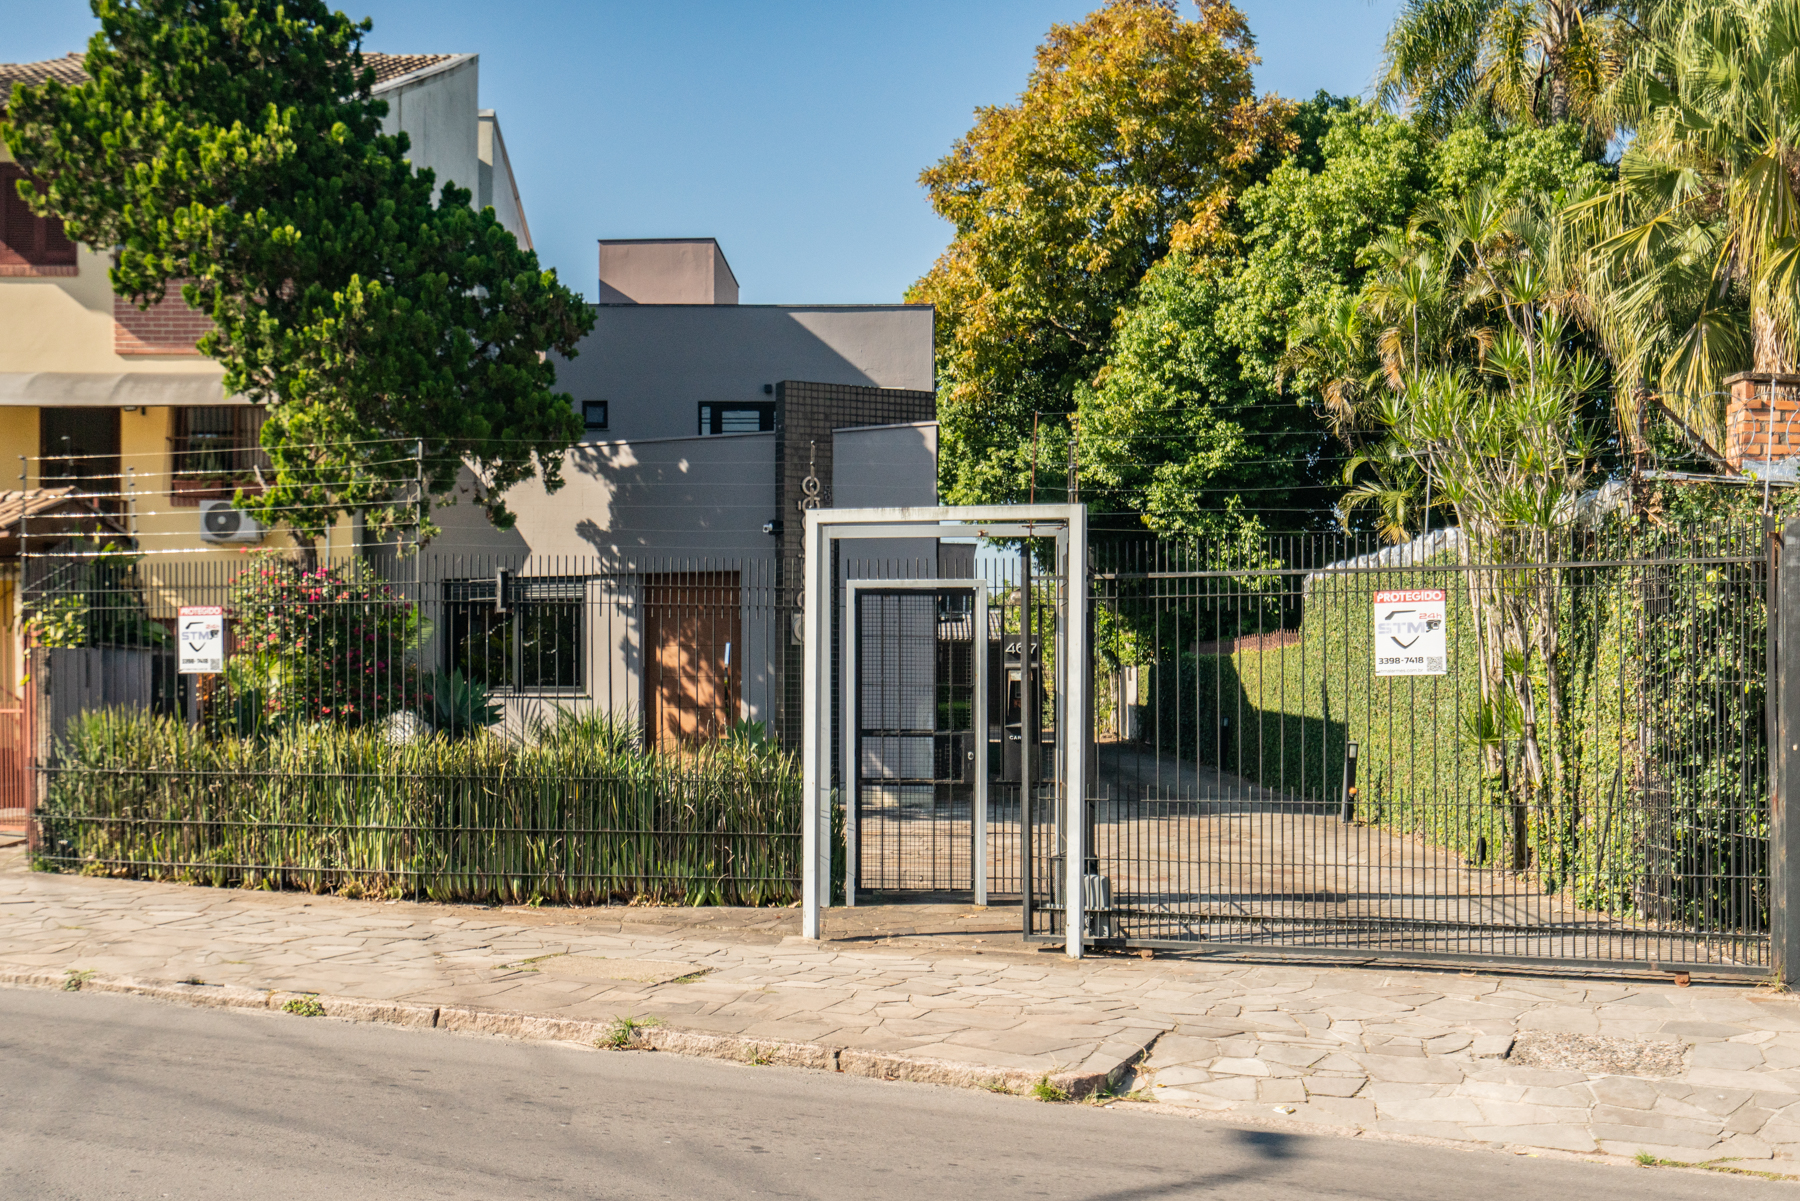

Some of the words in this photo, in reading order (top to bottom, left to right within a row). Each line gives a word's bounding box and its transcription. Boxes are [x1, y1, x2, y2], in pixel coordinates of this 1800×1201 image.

[1376, 591, 1442, 603] PROTEGIDO
[1418, 612, 1442, 620] 24h
[1378, 622, 1425, 635] STM
[181, 631, 210, 641] STM
[1378, 656, 1424, 665] 3398-7418
